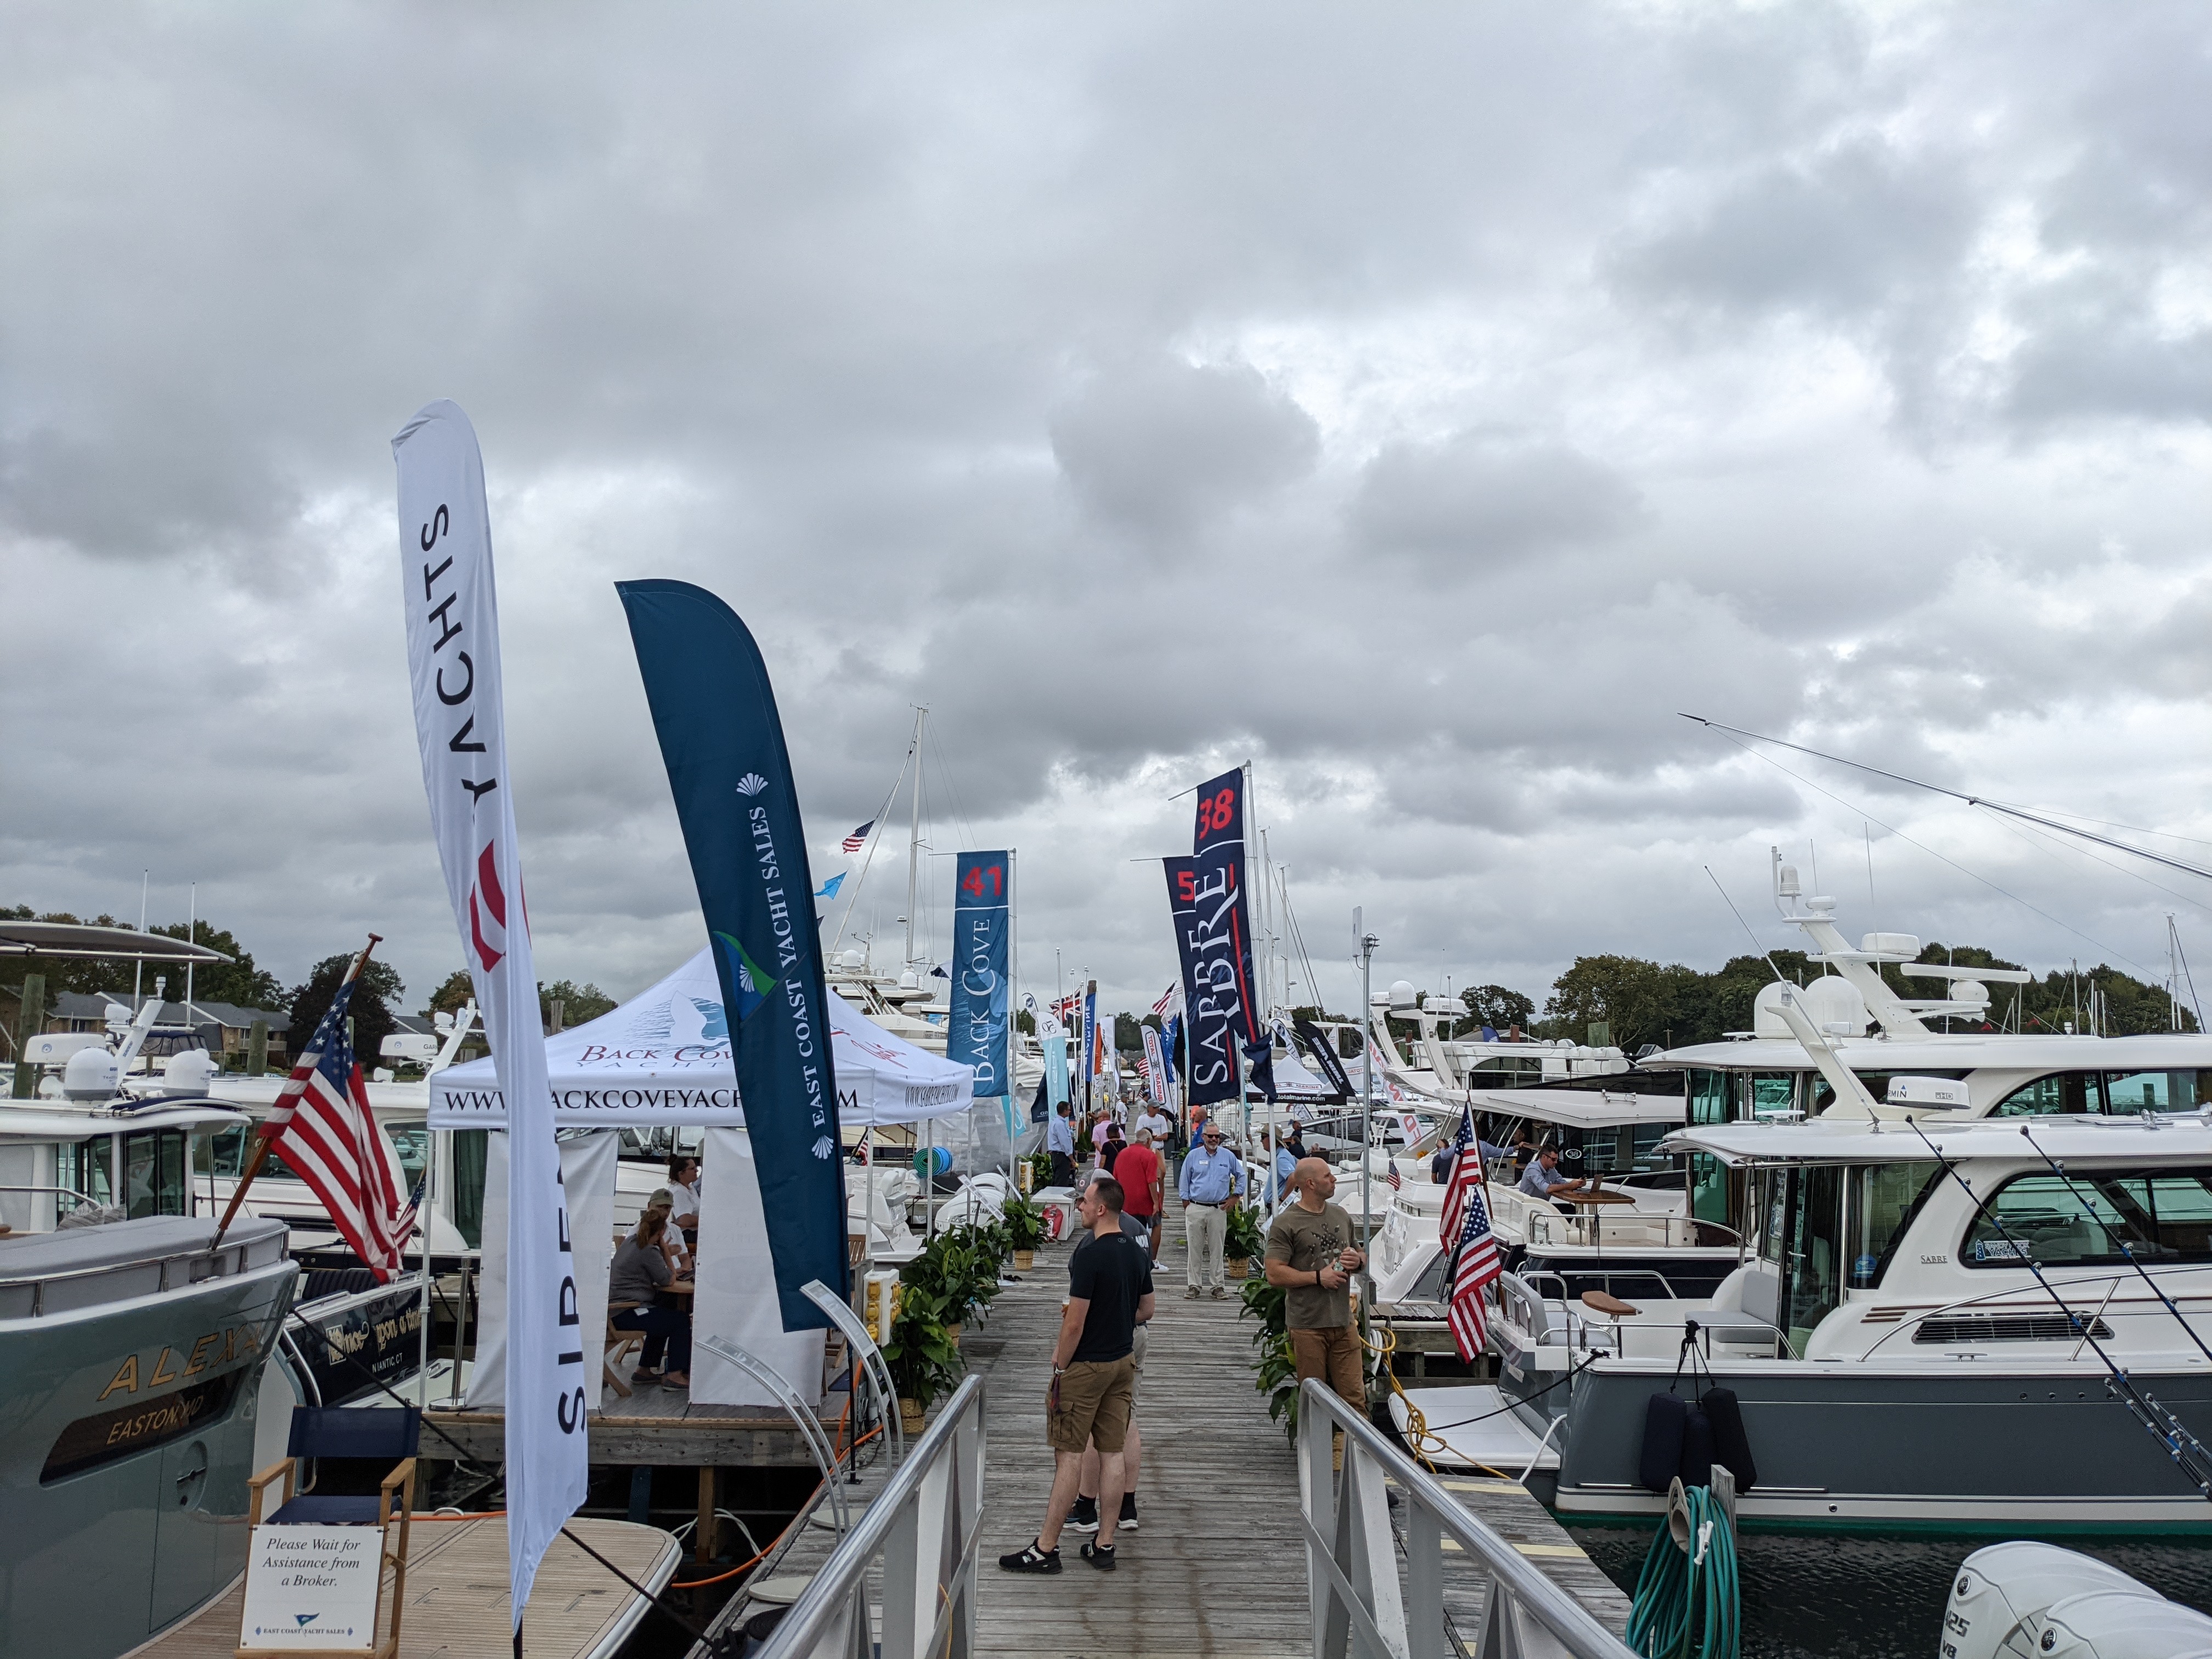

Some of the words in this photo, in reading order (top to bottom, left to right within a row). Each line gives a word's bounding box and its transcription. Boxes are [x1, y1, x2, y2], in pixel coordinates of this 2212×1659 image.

[421, 503, 498, 825] YACHTS
[749, 806, 780, 879] SALES
[962, 866, 1002, 897] 41
[766, 887, 797, 968] YACHT
[962, 919, 996, 996] COVE
[786, 979, 813, 1058] COAST
[577, 1045, 661, 1061] BACK
[674, 1046, 733, 1061] COV
[967, 1008, 995, 1084] BACK
[1147, 1035, 1156, 1057] TOTAL
[1154, 1073, 1164, 1102] MARINE
[803, 1065, 826, 1128] EAST
[1887, 1090, 1907, 1098] RMIN
[1920, 1254, 1948, 1263] SABRE
[1988, 1247, 2028, 1256] YACHS
[396, 1352, 403, 1364] CT
[267, 1538, 308, 1550] Please
[313, 1538, 340, 1550] Wait
[339, 1539, 361, 1553] for
[262, 1556, 329, 1568] Assistance
[328, 1557, 360, 1571] from
[281, 1577, 290, 1587] a
[293, 1574, 338, 1587] Broker.
